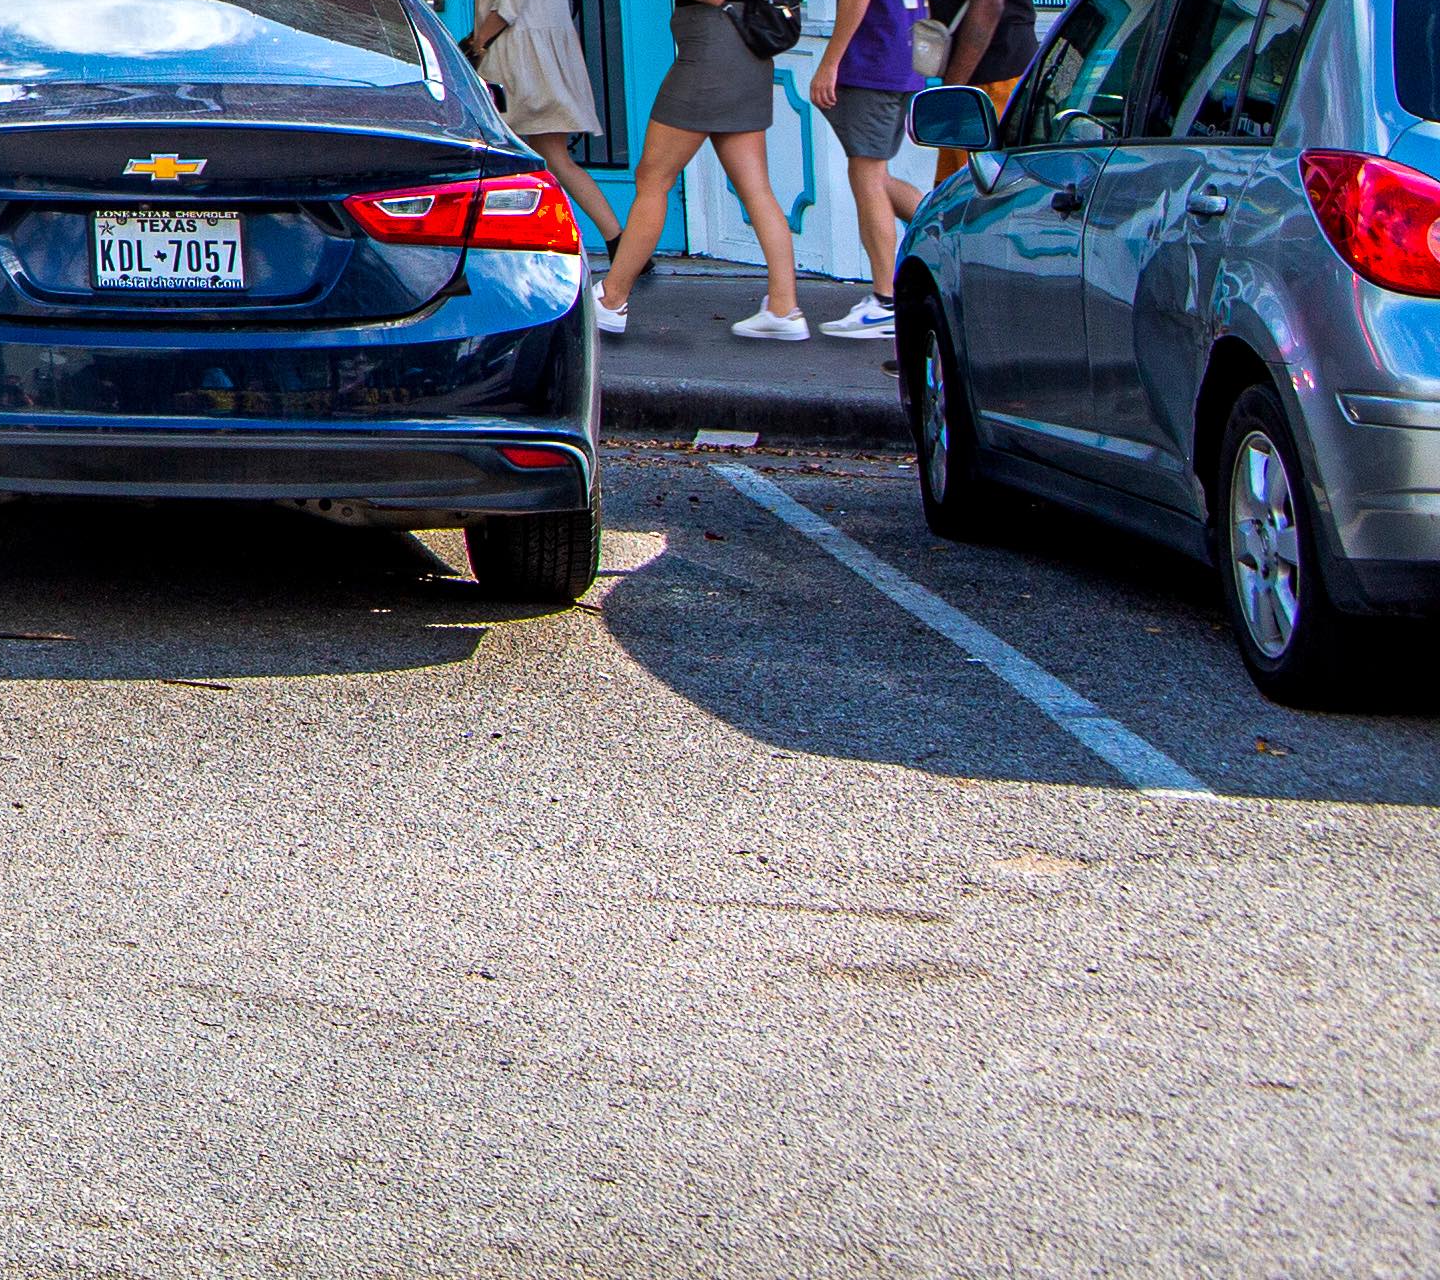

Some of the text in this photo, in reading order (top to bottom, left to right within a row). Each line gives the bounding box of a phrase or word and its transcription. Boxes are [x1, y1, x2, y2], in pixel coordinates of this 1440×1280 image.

[175, 210, 238, 219] CHEVROLET
[136, 219, 197, 233] TEXAS
[98, 276, 244, 289] lonestarchevrolet.com
